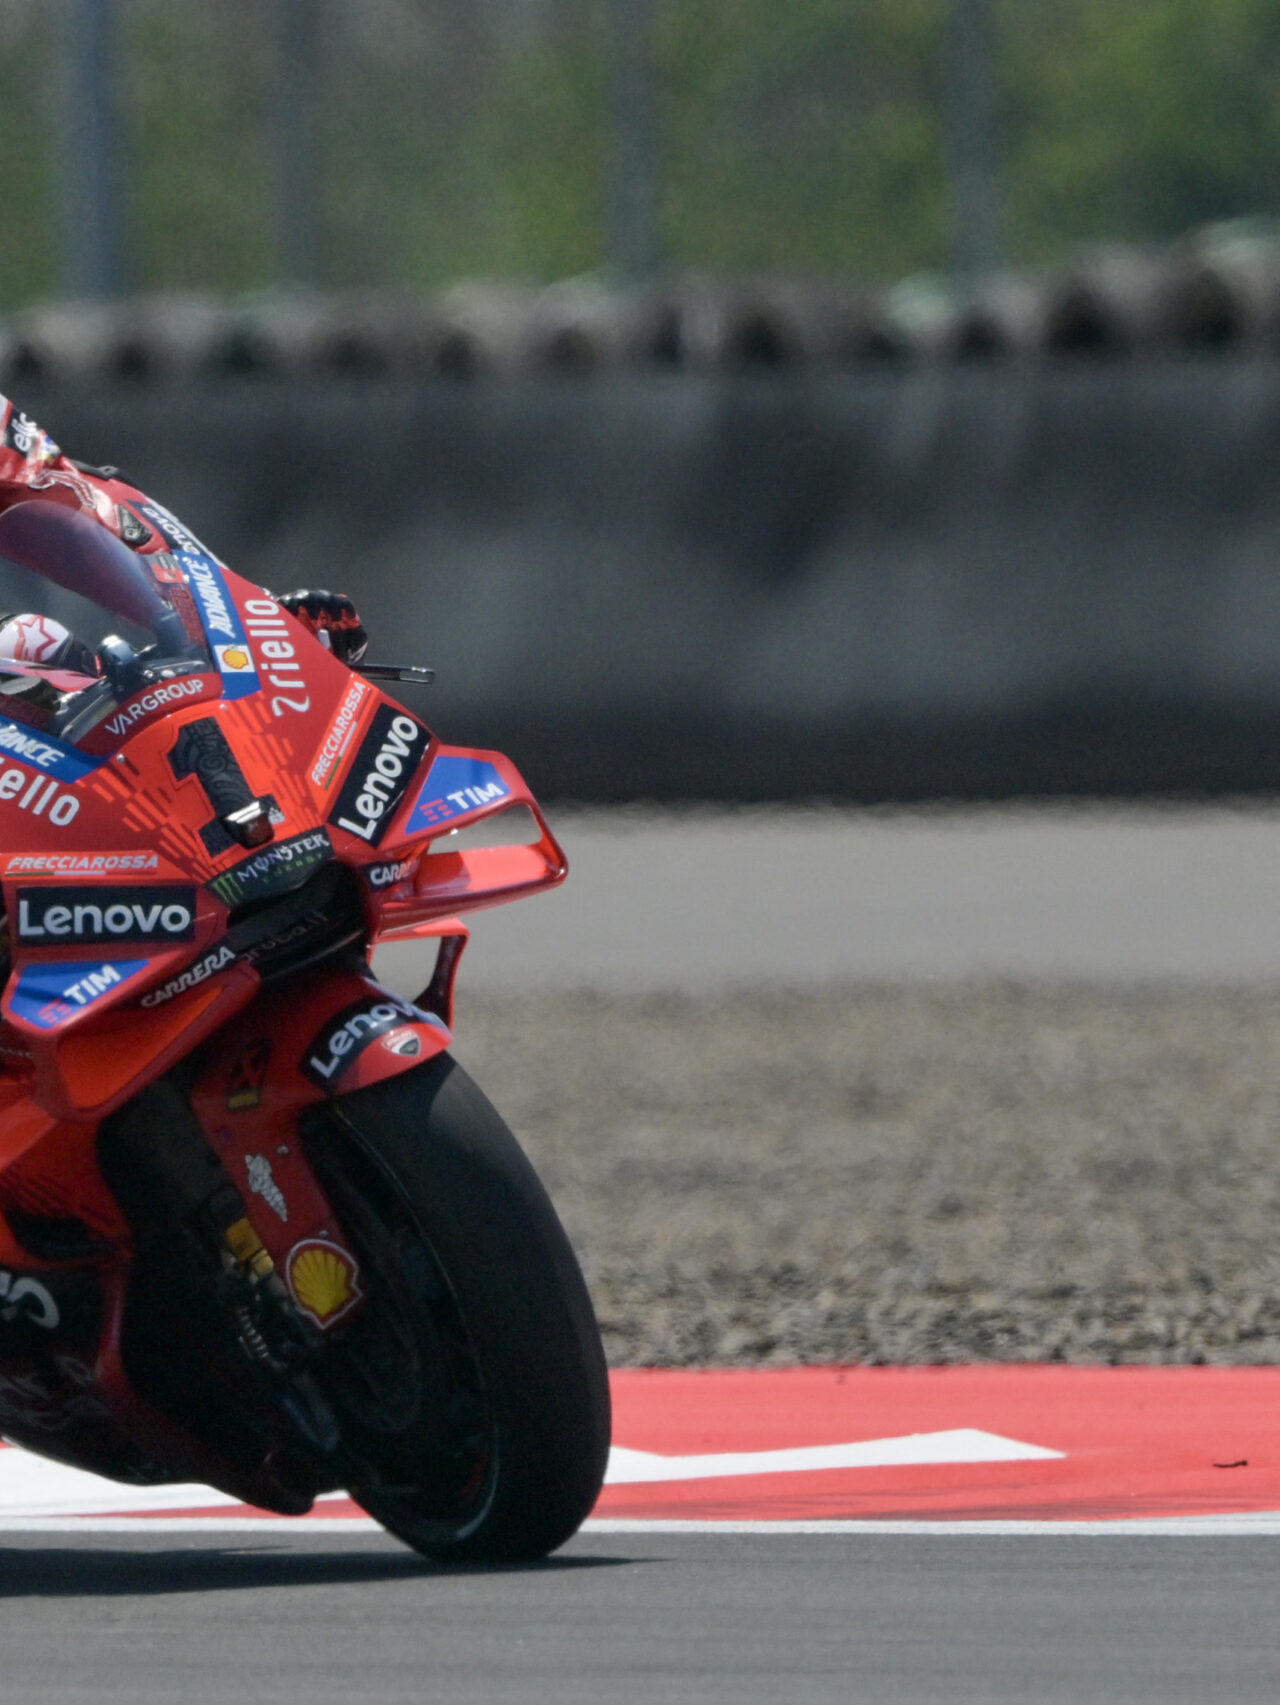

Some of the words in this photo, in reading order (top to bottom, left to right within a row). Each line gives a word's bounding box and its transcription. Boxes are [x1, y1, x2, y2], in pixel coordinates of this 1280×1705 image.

[142, 505, 201, 556] enovo
[105, 677, 205, 736] VARGROUP
[310, 680, 368, 787] FRECCIAROSSA
[167, 715, 285, 859] 1
[337, 715, 419, 841] Lenovo
[446, 782, 505, 812] TIM
[6, 854, 159, 871] FRECCIAROSSA
[236, 833, 331, 883] MONSTER
[369, 861, 414, 884] CARR
[19, 899, 192, 936] Lenovo
[63, 964, 123, 1007] TIM
[140, 945, 237, 1009] CARRERA
[310, 1002, 414, 1079] Lenov
